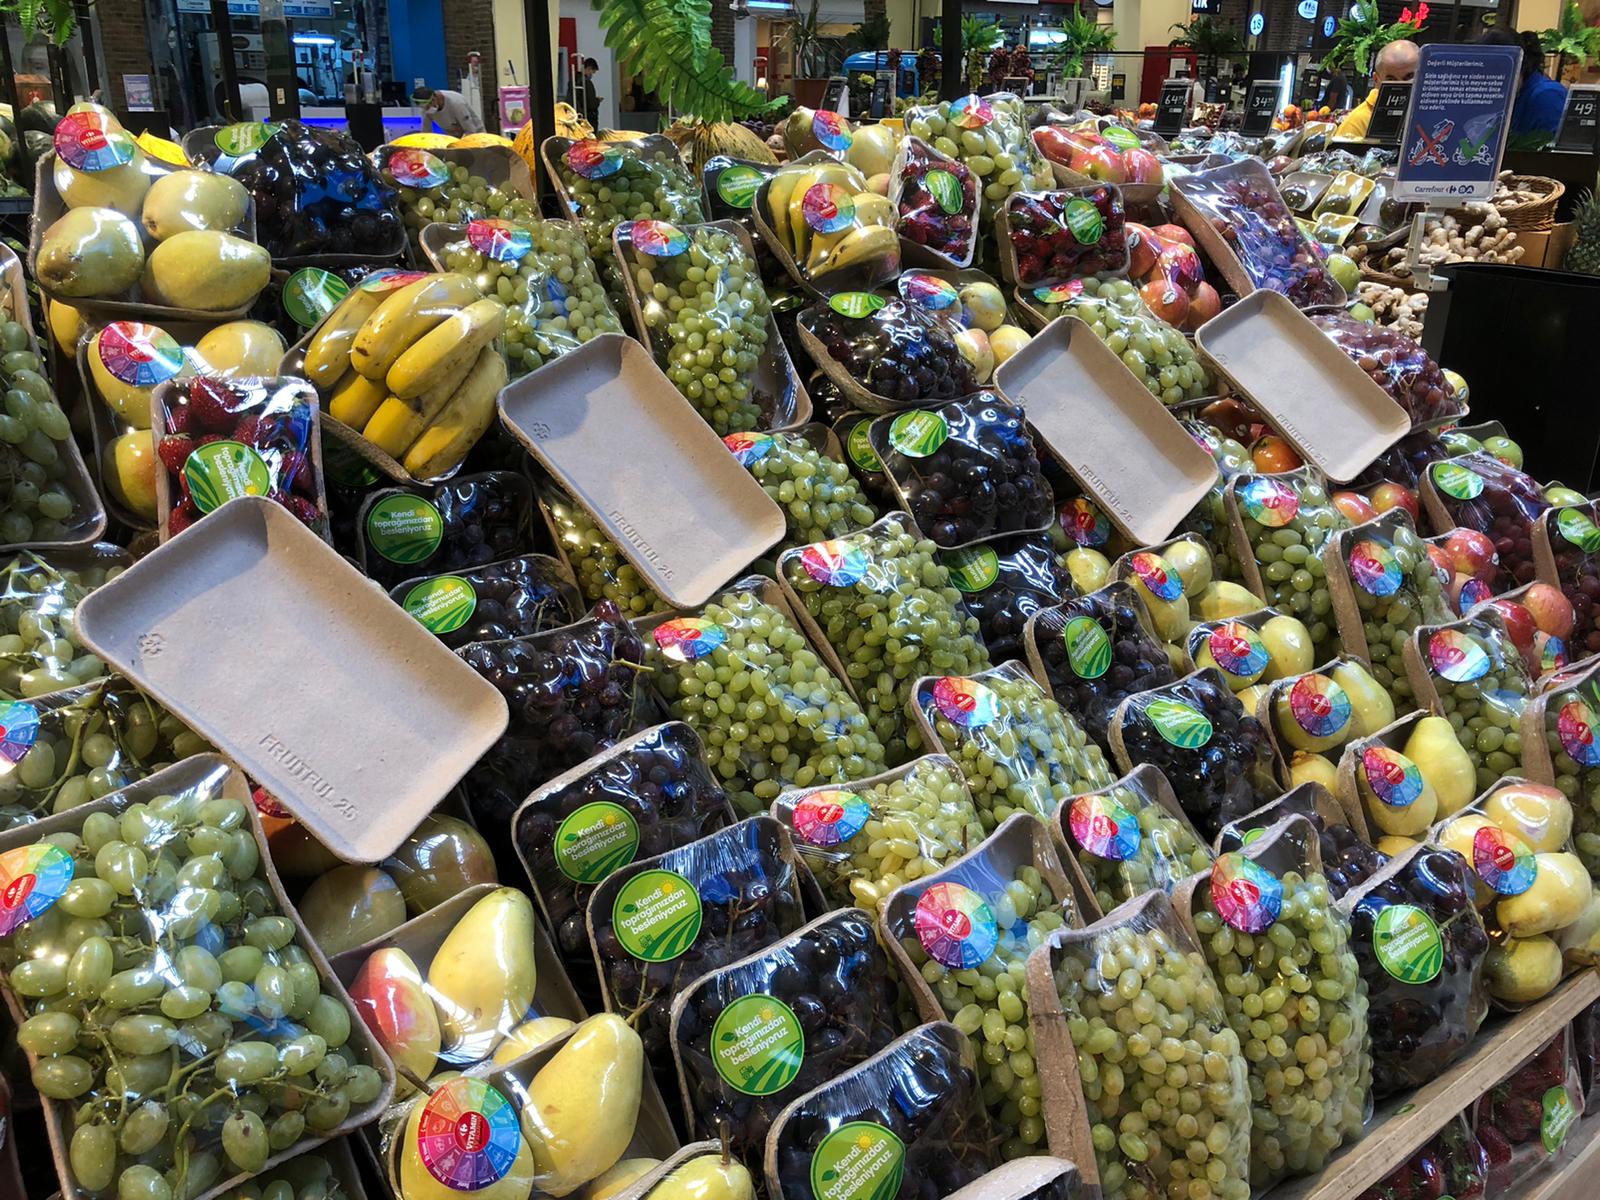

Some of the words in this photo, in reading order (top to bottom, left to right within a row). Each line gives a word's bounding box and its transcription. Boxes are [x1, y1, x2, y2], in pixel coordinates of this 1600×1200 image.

[1414, 185, 1444, 193] Carrefour
[1079, 464, 1122, 511] FRUITFUL
[391, 510, 415, 519] Kendi
[608, 509, 659, 566] FRUITFUL
[422, 588, 445, 603] Kendi
[258, 732, 336, 806] FRUITFUL
[333, 797, 359, 823] 25
[561, 820, 628, 857] toprağımızdan
[570, 831, 628, 862] besleniyoruz
[577, 818, 606, 839] Kendi
[620, 888, 687, 930] toprağımızdan
[634, 887, 663, 910] Kendi
[630, 899, 689, 936] besleniyoruz
[719, 1014, 786, 1059] toprağımızdan
[734, 1013, 763, 1038] Kendi
[730, 1027, 789, 1066] besleniyoruz
[824, 1138, 888, 1200] toprağımızdan
[833, 1143, 862, 1173] Kendi
[836, 1149, 894, 1200] besleniyoruz
